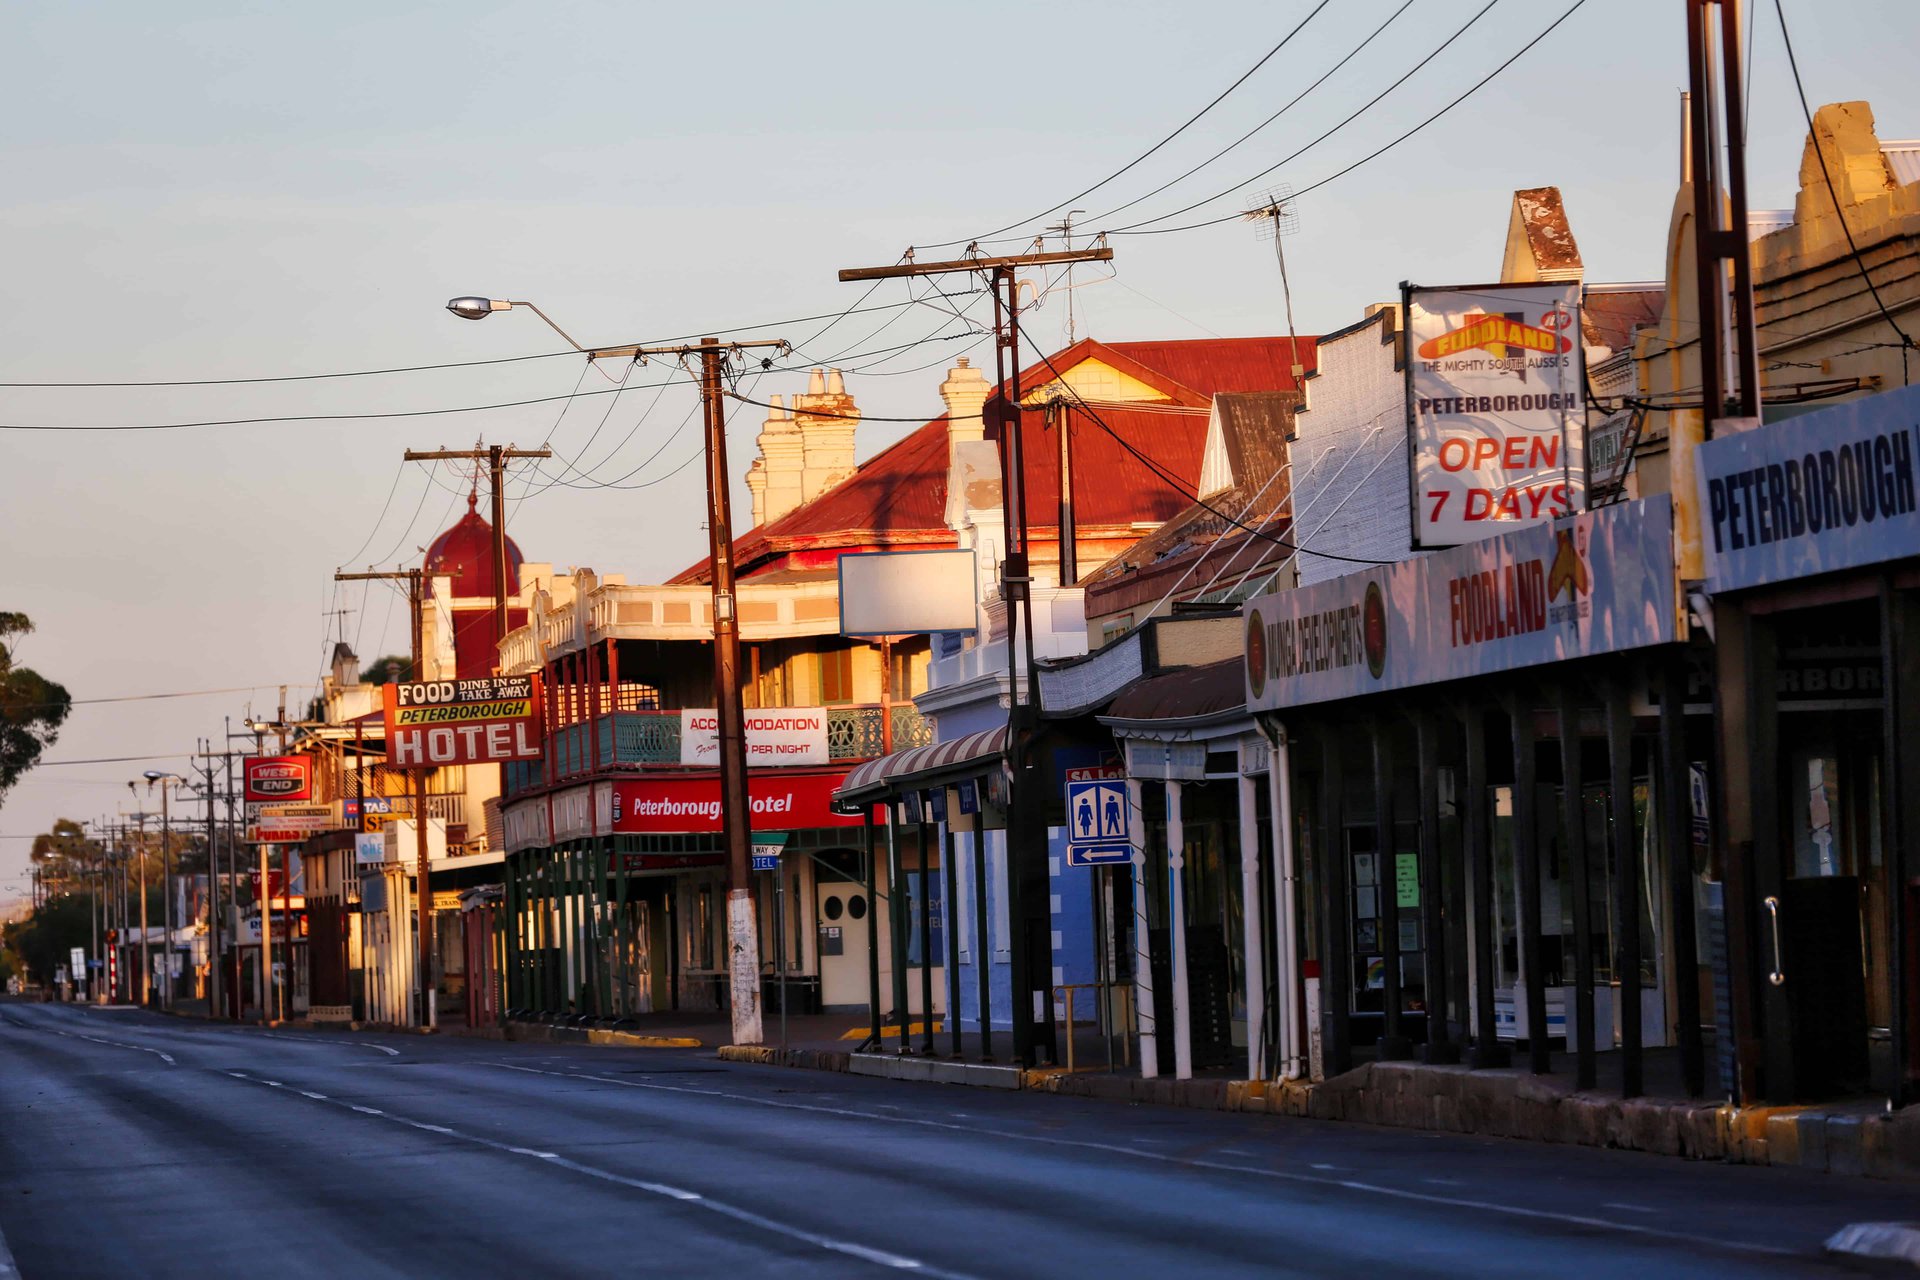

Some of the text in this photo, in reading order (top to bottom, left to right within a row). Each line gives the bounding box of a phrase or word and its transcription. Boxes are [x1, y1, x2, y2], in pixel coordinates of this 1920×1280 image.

[1437, 320, 1556, 355] FOODLAND
[1422, 356, 1569, 373] THE MIGHTY SOUTH AUSSIS
[1419, 392, 1576, 415] PETERBOROUGH
[1438, 435, 1560, 472] OPEN
[1708, 429, 1916, 553] PETERBOROUGH
[1426, 484, 1576, 523] 7 DAYS
[1449, 559, 1546, 648] FOODLAND
[1298, 603, 1362, 674] DEVELOPMENTS
[398, 682, 454, 706] FOOD
[459, 680, 490, 691] DINE
[493, 678, 507, 688] IN
[459, 684, 530, 701] TAKE AWAY
[400, 702, 526, 723] PETERBOROUGH
[690, 718, 819, 730] ACCMODATION
[394, 722, 540, 765] HOTEL
[695, 744, 717, 757] From
[751, 744, 773, 754] PER
[776, 744, 810, 754] NIGHT
[258, 767, 296, 778] WEST
[1071, 770, 1092, 781] SA
[262, 780, 292, 790] END
[364, 802, 388, 813] TAB
[634, 797, 723, 820] Peterboroug
